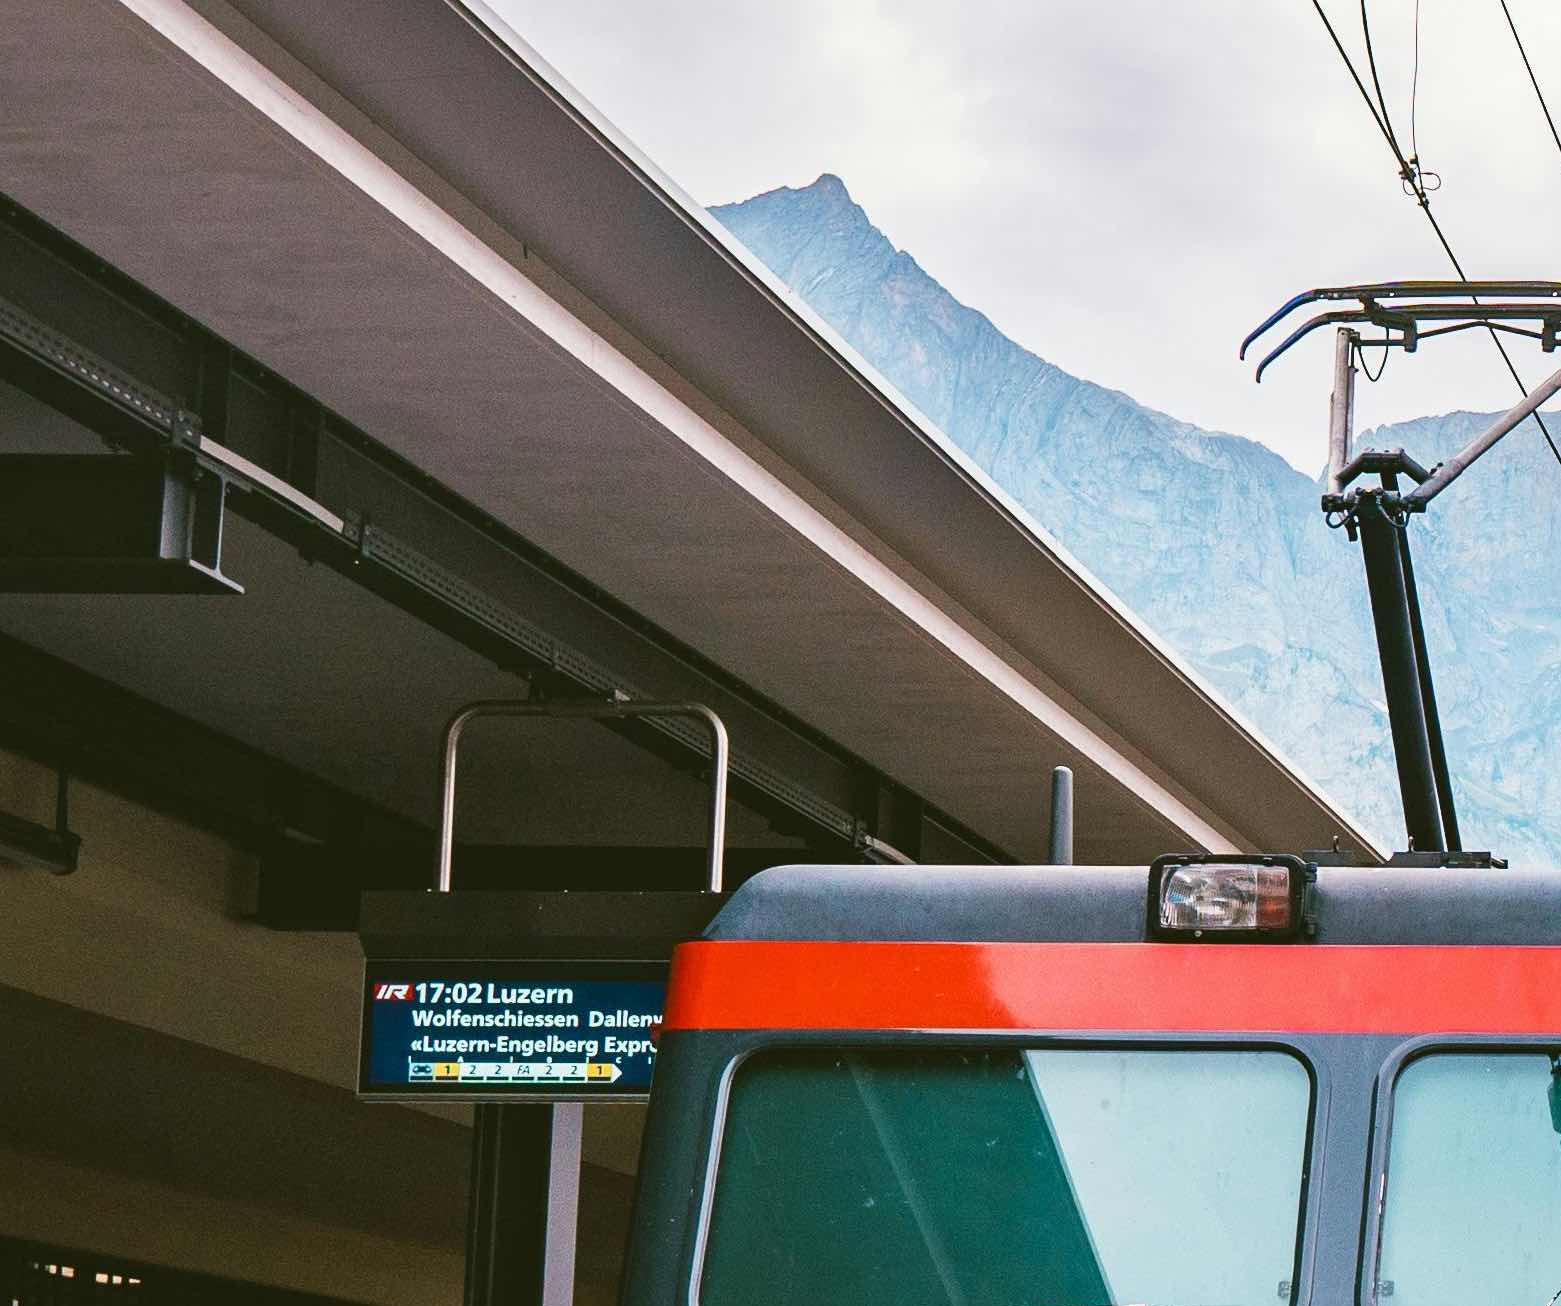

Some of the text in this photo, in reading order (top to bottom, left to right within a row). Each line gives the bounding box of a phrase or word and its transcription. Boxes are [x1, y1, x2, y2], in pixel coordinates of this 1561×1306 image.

[376, 982, 574, 1004] IR 17:02 Luzern
[411, 1008, 579, 1027] Wolfenschiessen
[470, 1064, 477, 1075] 2
[494, 1064, 502, 1075] 2
[545, 1065, 553, 1075] 2
[571, 1065, 578, 1075] 2
